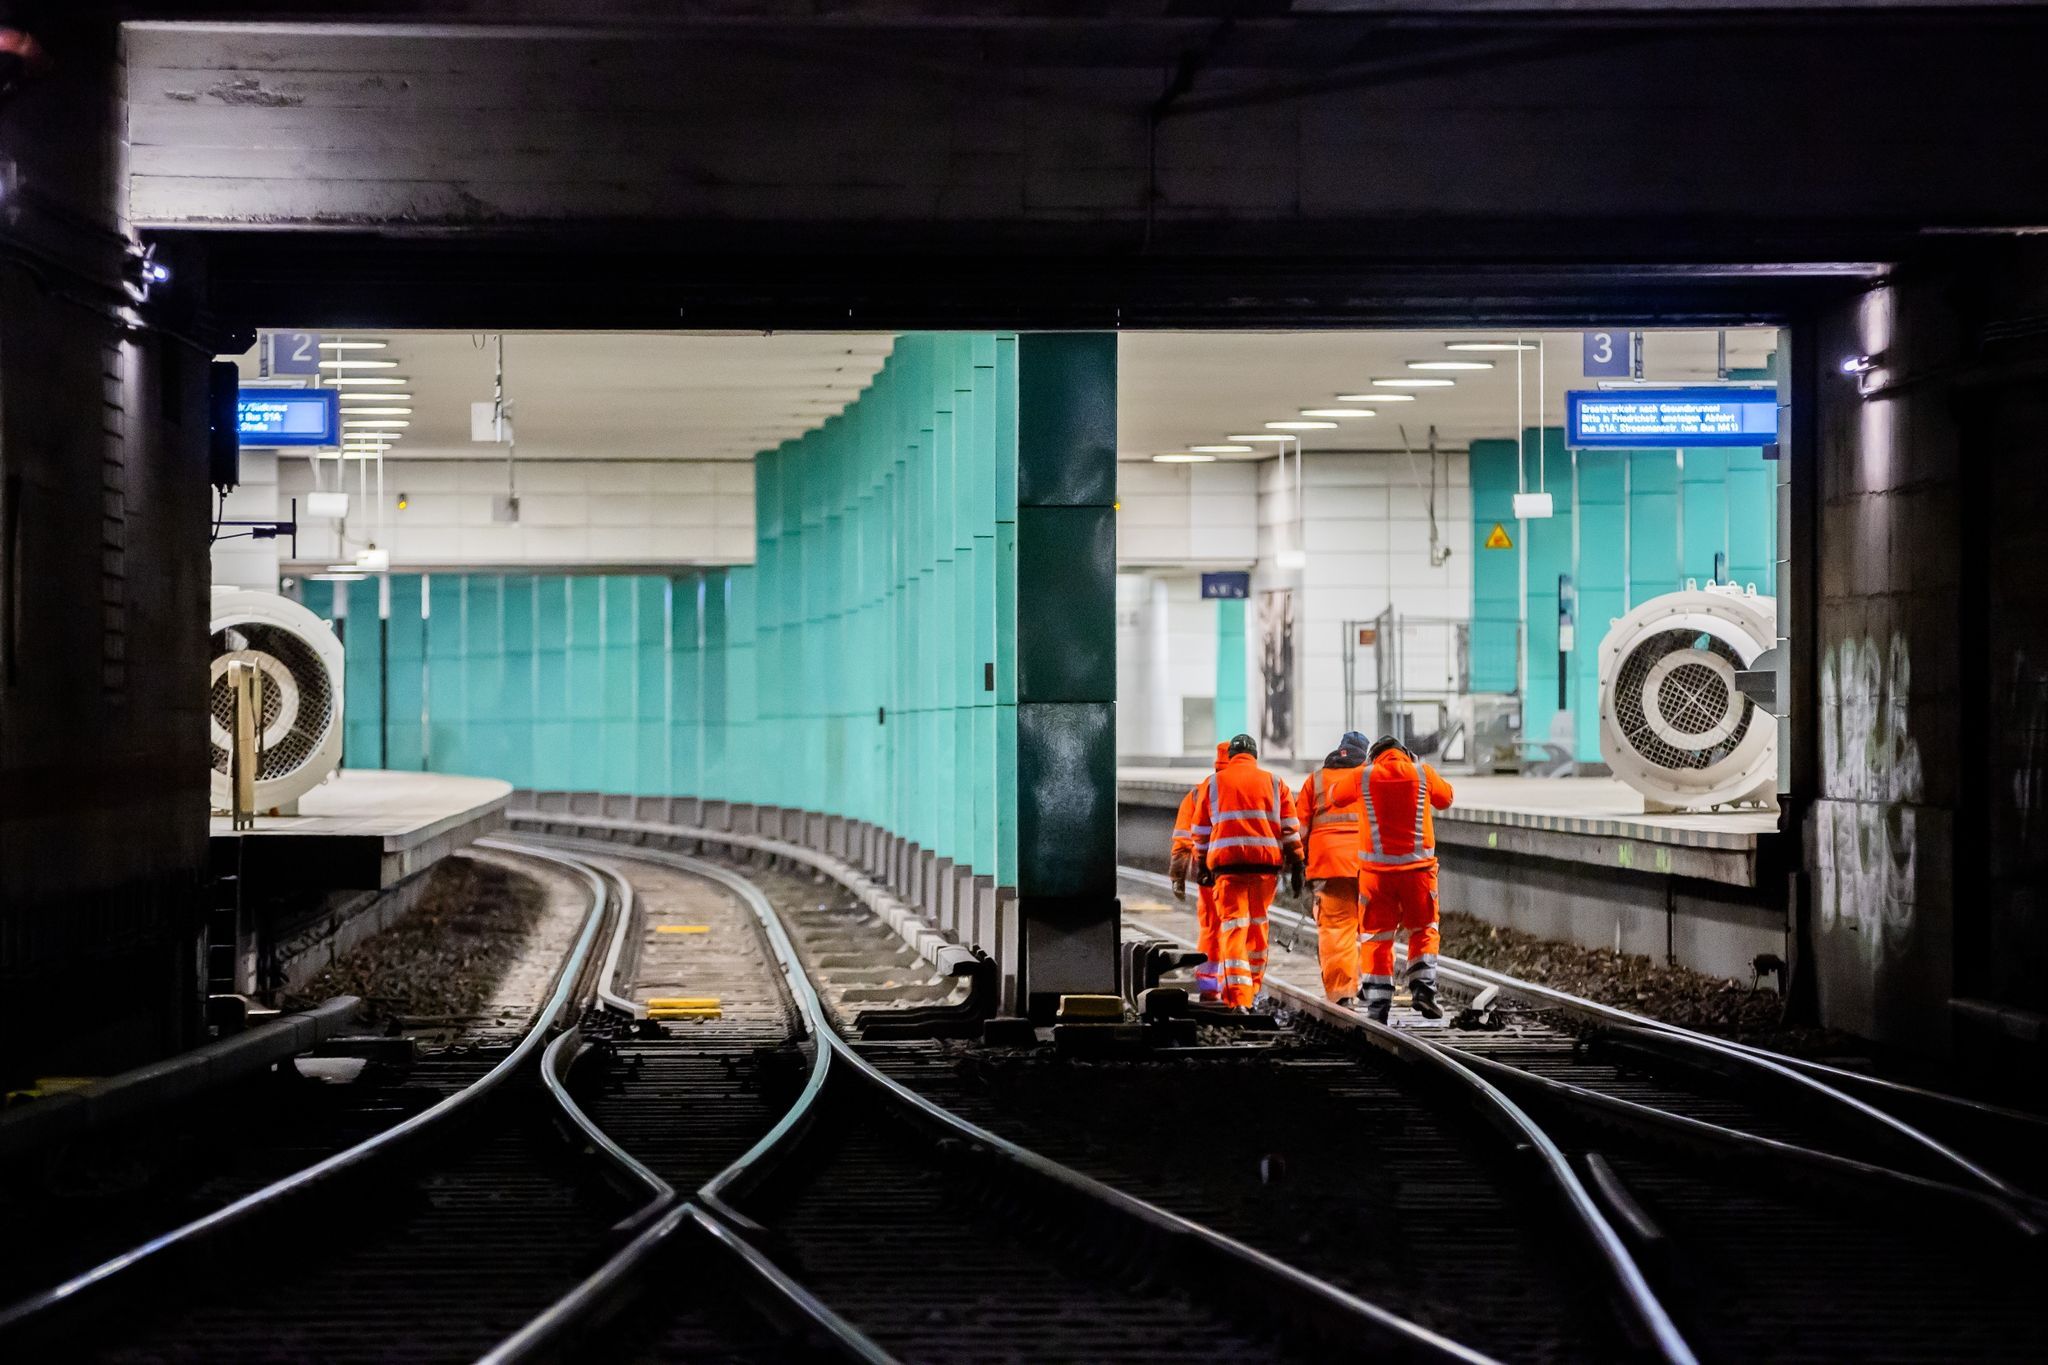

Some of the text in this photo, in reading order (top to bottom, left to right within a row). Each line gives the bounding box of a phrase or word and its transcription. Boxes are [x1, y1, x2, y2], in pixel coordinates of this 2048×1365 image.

[292, 333, 313, 361] 2
[1592, 332, 1613, 363] 3
[1582, 404, 1637, 413] Ersatzverkehr
[1639, 404, 1658, 413] nach
[1582, 413, 1735, 424] Bitte in Friedrichstr. umsteigen. Abfahrt
[1582, 423, 1597, 432] Bus
[1599, 423, 1618, 432] S1A:
[1620, 423, 1678, 432] Stresemannstr.
[1700, 422, 1715, 432] Bus
